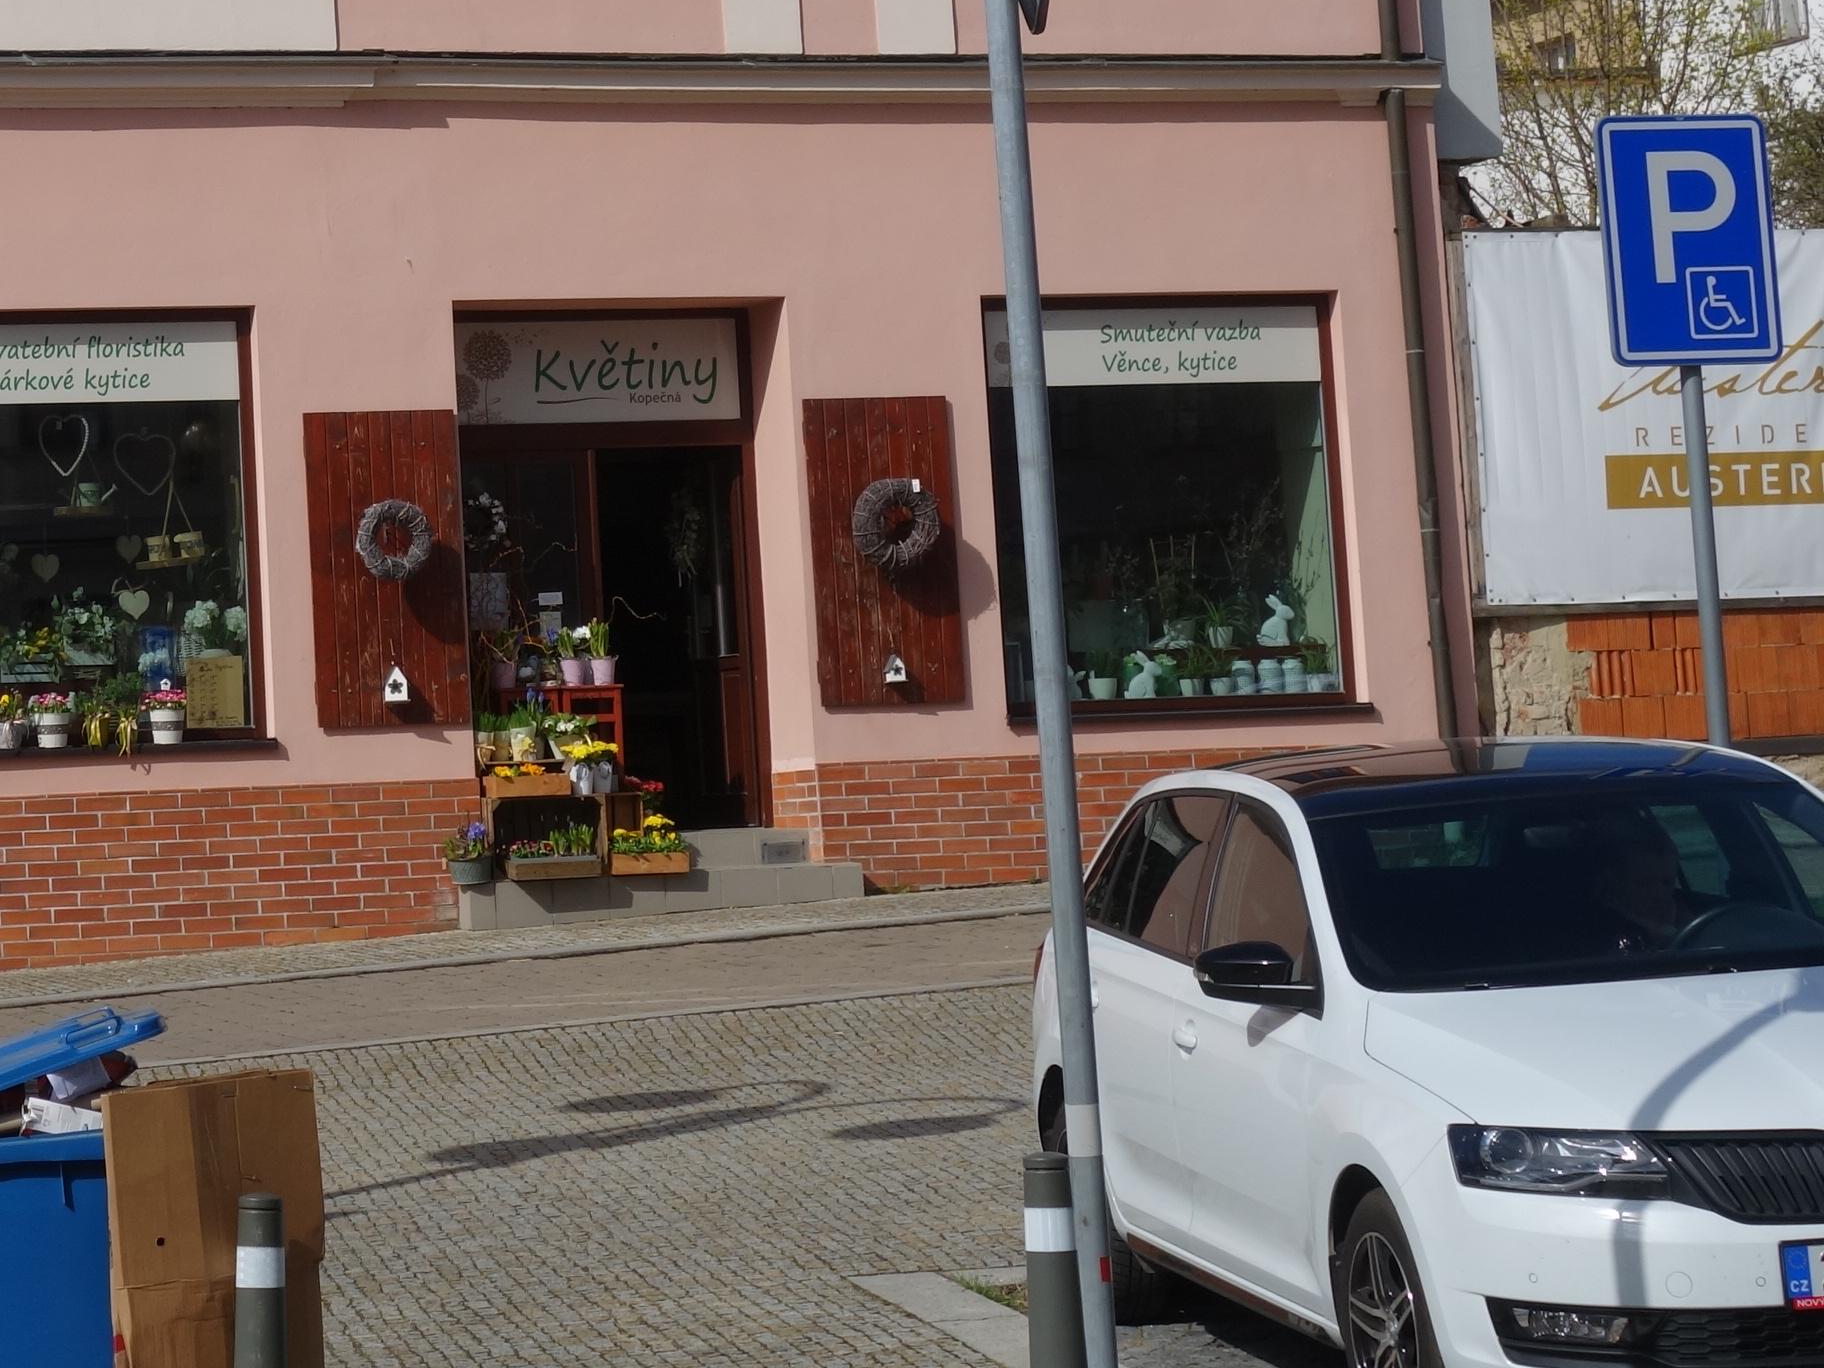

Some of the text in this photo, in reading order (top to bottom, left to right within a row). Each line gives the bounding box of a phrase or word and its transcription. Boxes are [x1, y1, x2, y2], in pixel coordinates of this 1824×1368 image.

[1645, 150, 1737, 284] P
[1100, 319, 1261, 344] Smuteční vazba
[87, 335, 185, 359] floristika
[534, 339, 718, 405] Květiny
[1102, 350, 1238, 378] Věnce, kytice
[84, 367, 151, 396] kytice
[629, 391, 682, 406] Kopečná
[1639, 462, 1824, 499] AUSTER
[1790, 1279, 1810, 1293] CZ
